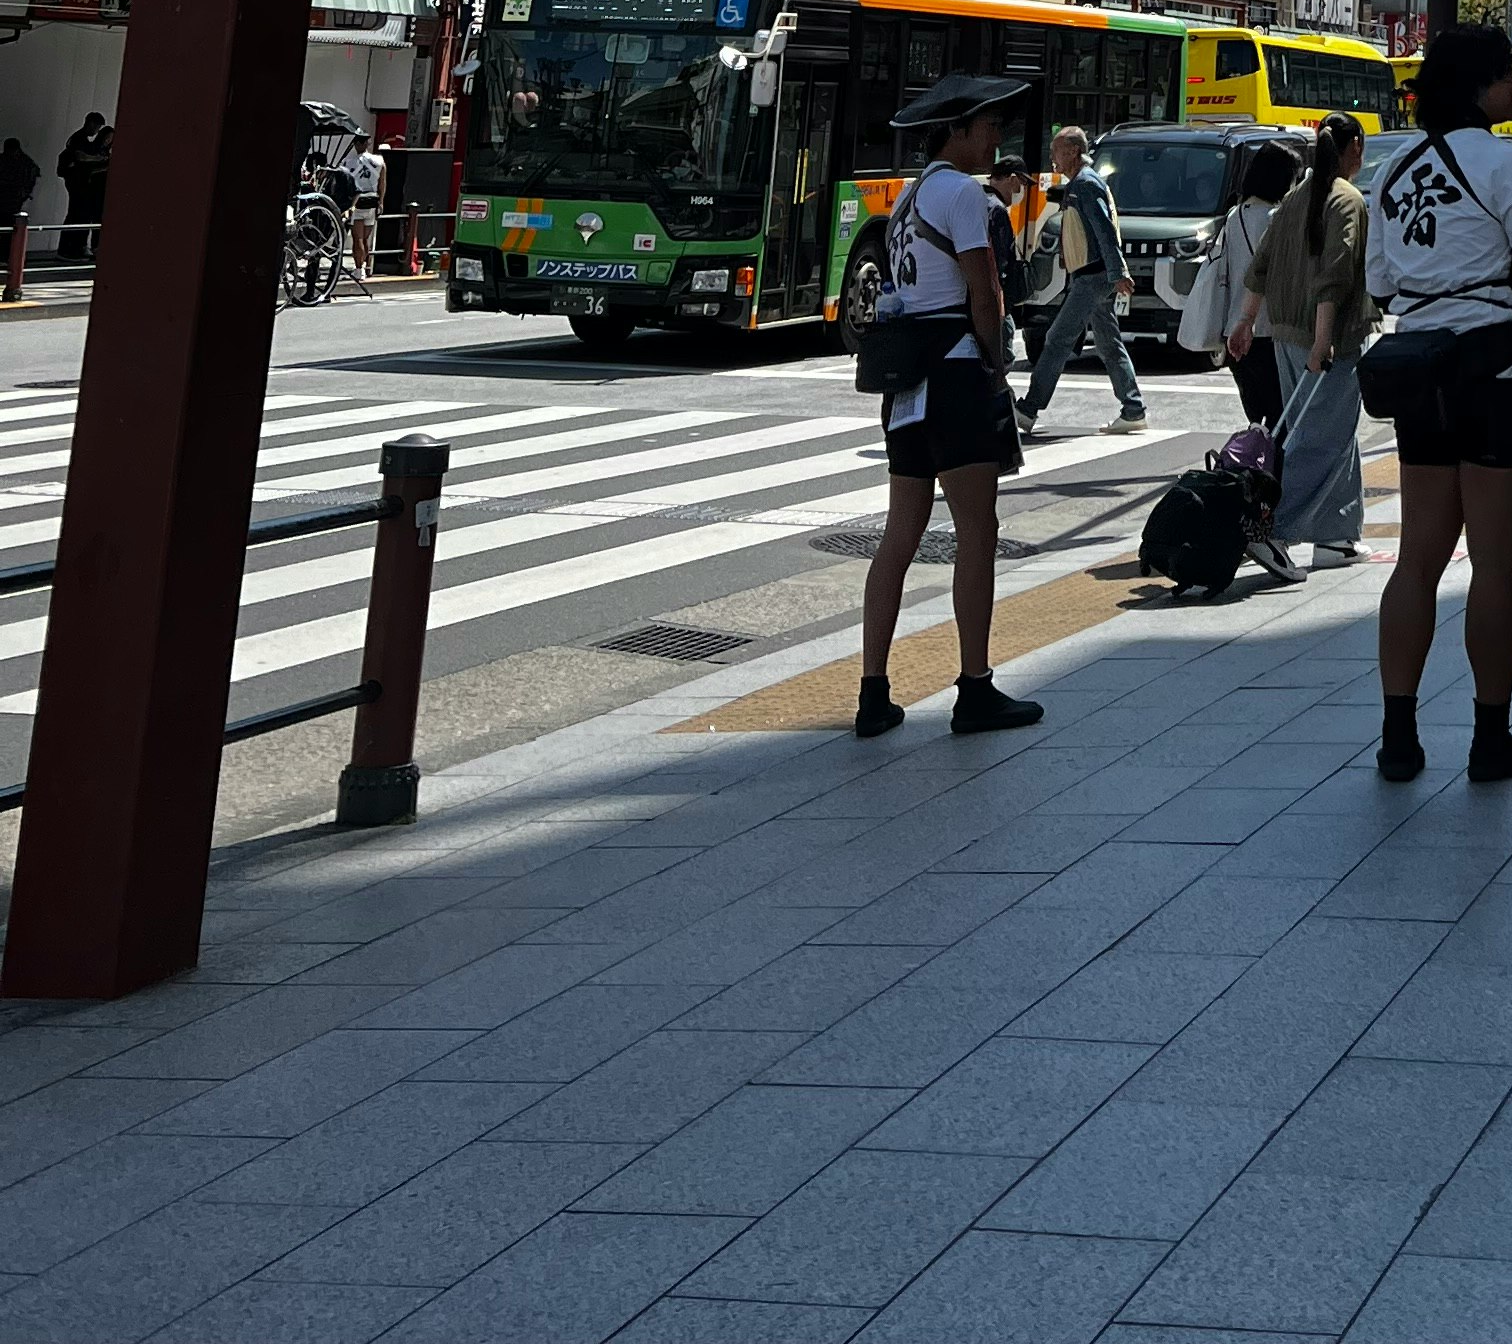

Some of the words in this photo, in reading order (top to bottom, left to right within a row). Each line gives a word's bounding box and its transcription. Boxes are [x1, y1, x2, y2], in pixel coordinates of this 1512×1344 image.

[690, 195, 714, 205] H964
[536, 261, 637, 279] ノンステップバス
[584, 295, 605, 315] 36
